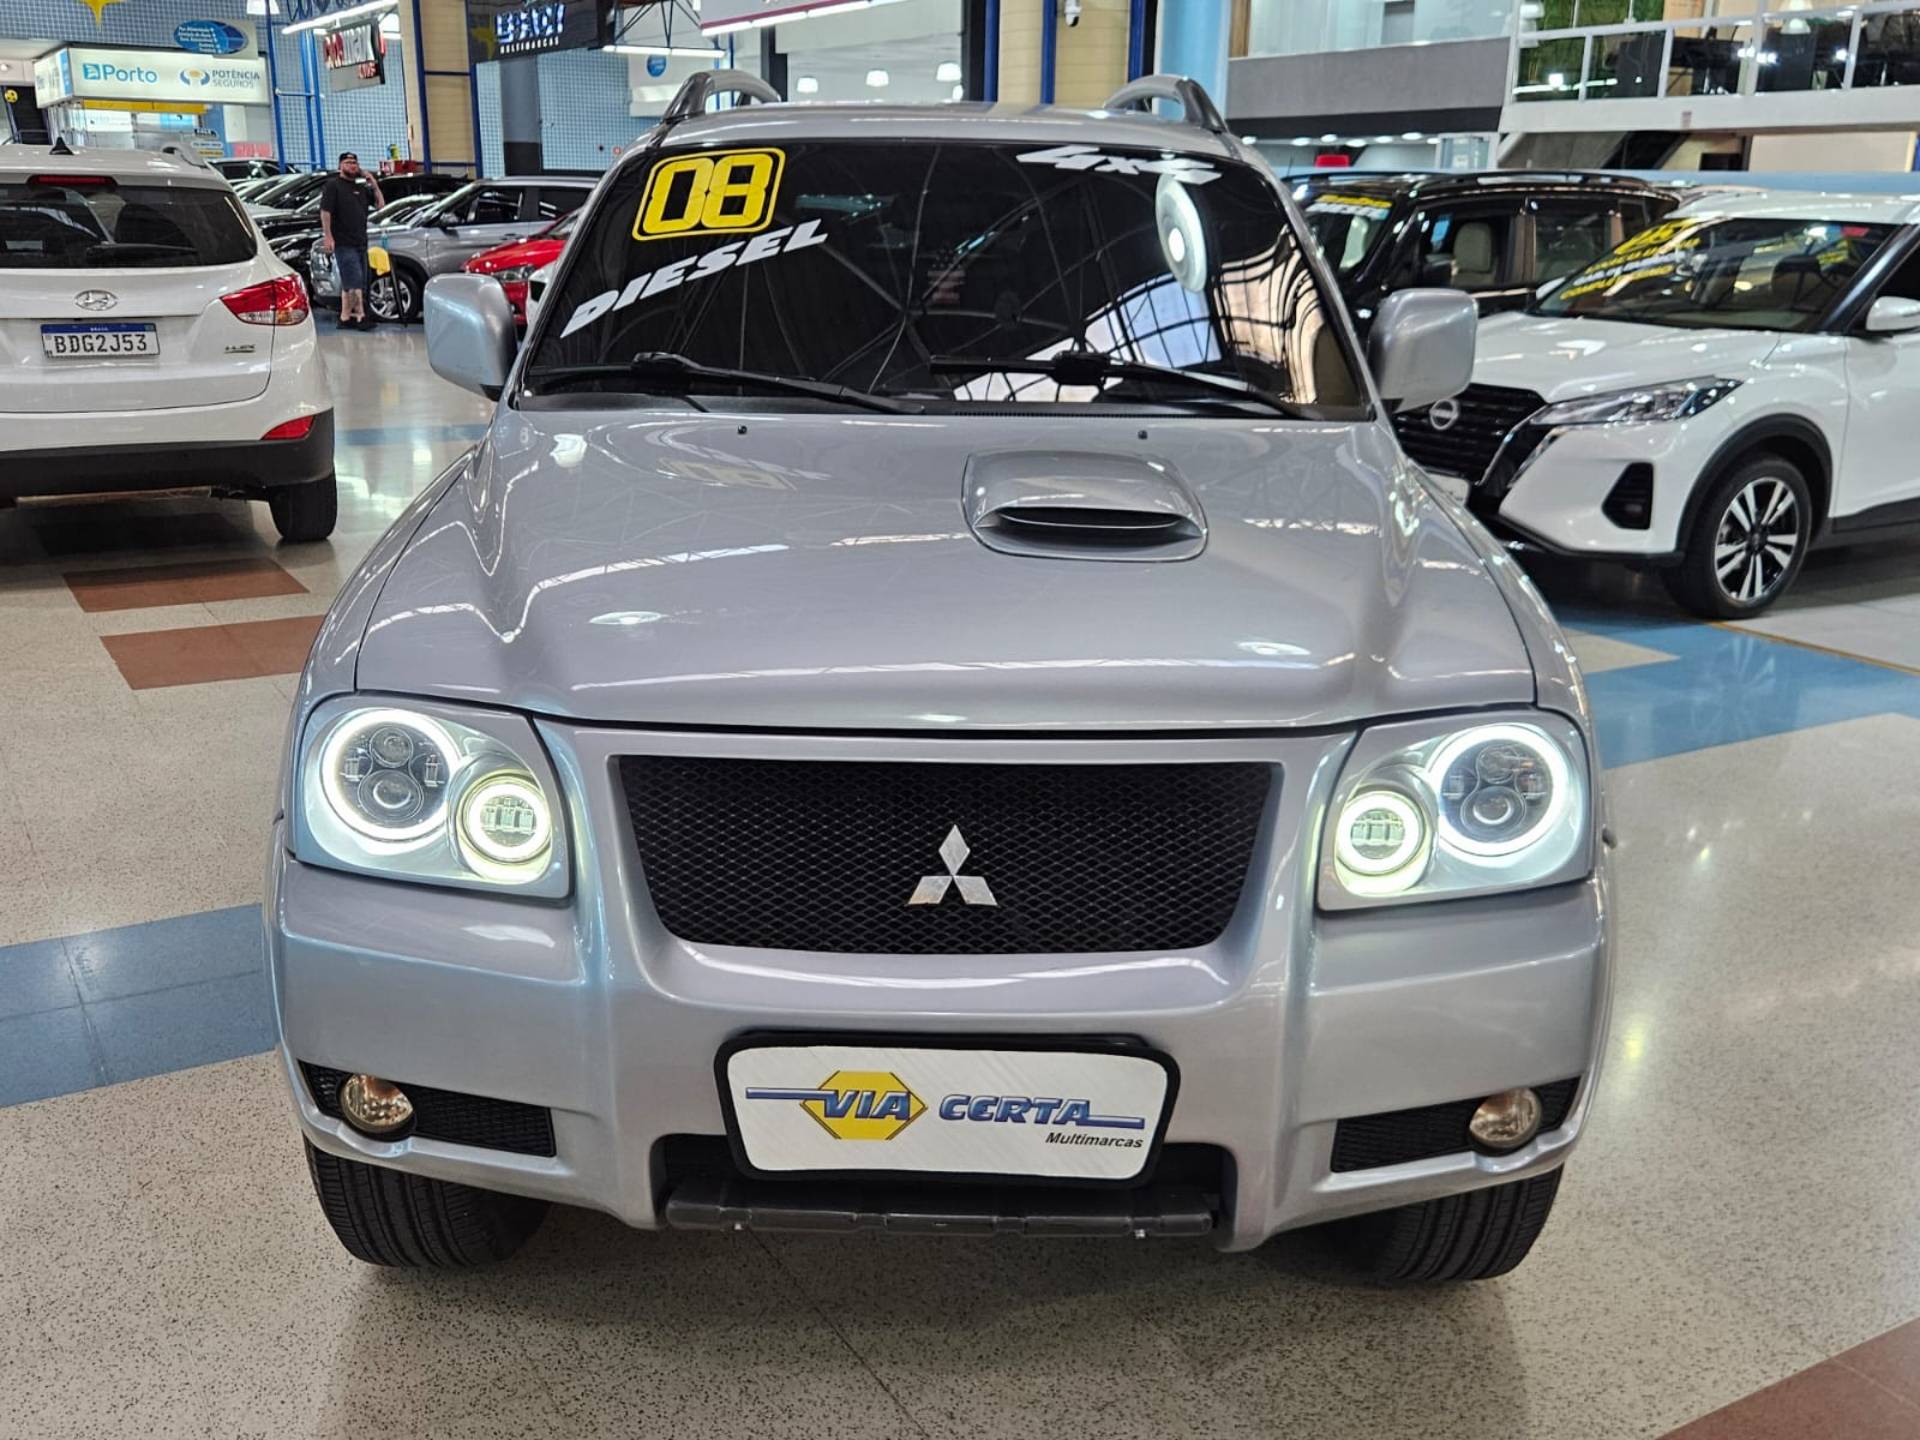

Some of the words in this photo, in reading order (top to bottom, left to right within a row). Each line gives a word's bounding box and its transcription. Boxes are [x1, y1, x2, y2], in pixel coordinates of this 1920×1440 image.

[103, 64, 158, 84] Porto
[642, 153, 774, 235] 08
[559, 218, 829, 339] DIESEL
[54, 333, 148, 354] BDG2J53
[820, 1089, 913, 1121] VIA
[938, 1093, 1092, 1126] CERTA
[1044, 1131, 1144, 1149] Multimarcas
